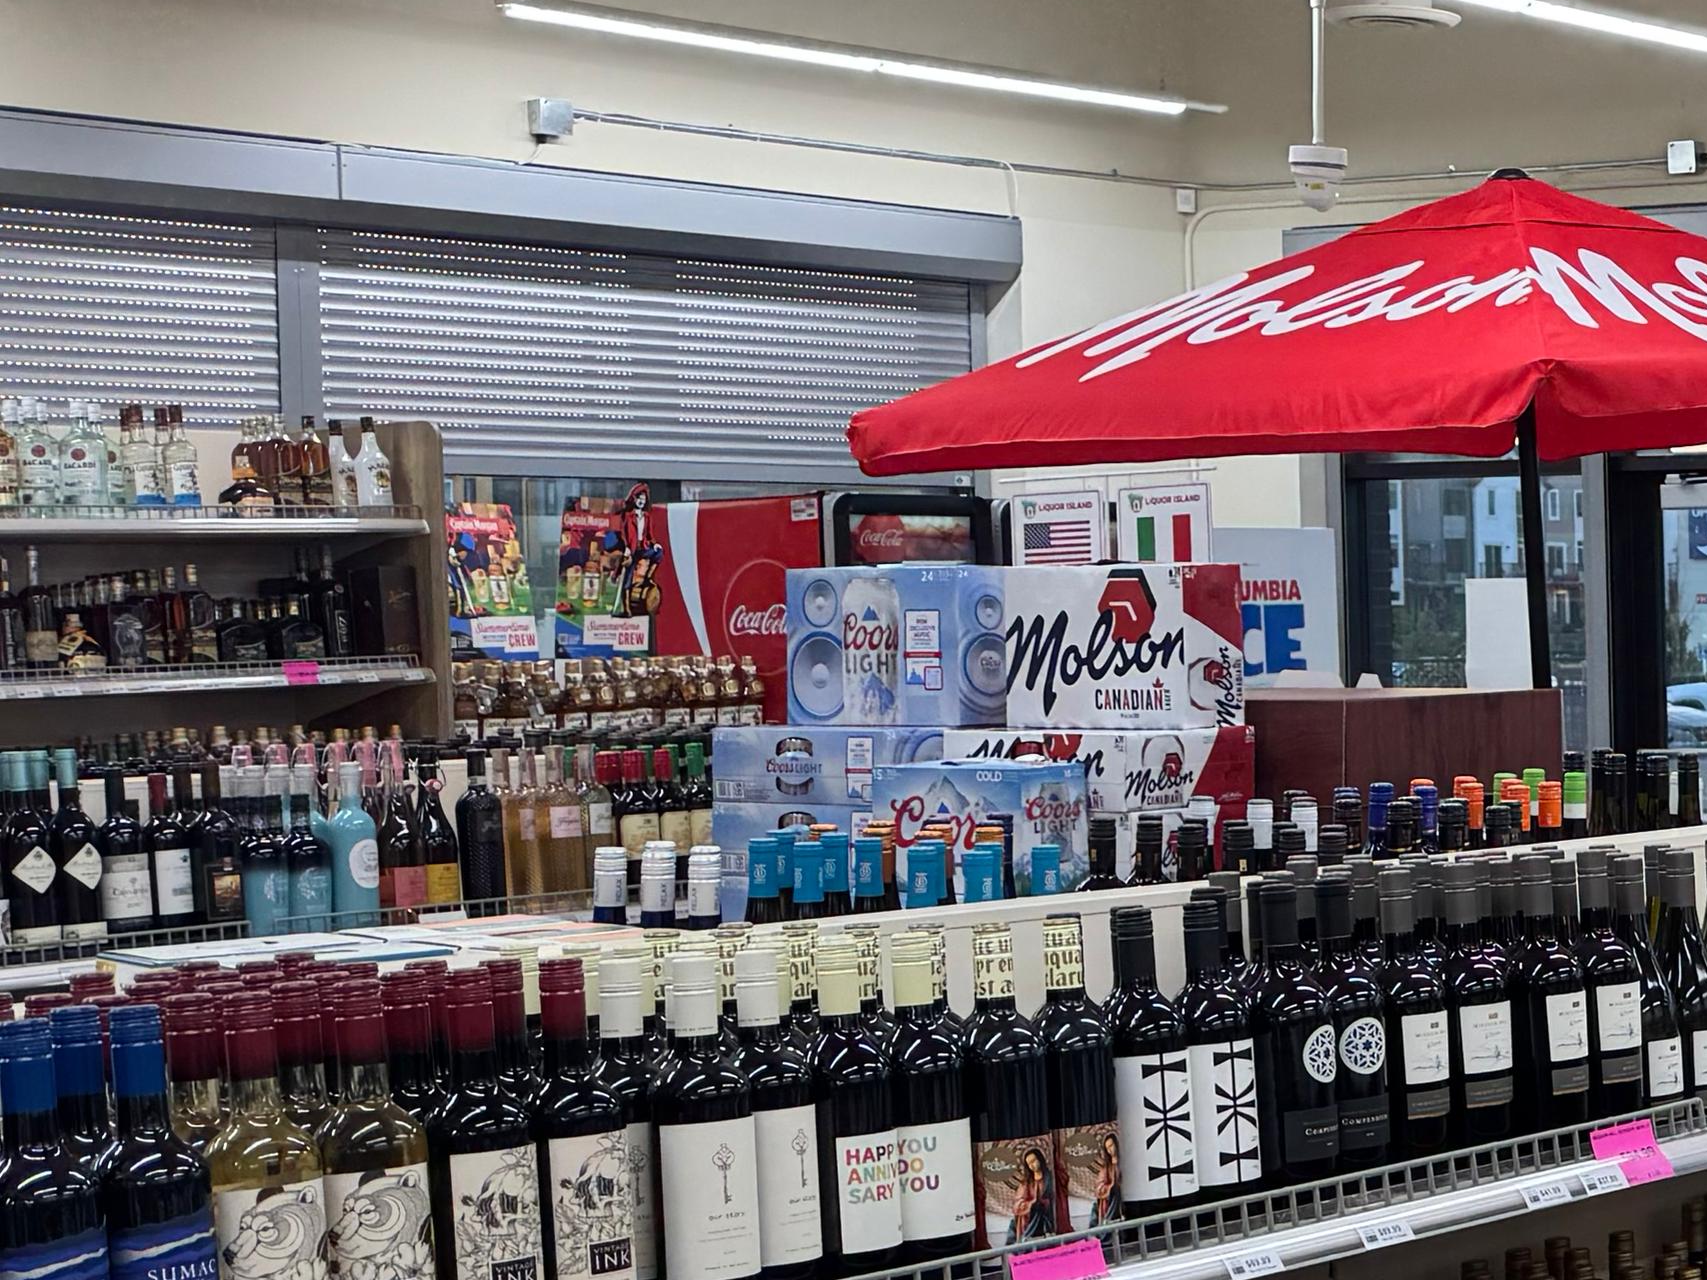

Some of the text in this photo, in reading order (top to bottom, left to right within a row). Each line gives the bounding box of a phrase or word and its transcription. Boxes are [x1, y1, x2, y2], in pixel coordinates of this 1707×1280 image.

[1015, 255, 1530, 383] Molson
[1066, 500, 1093, 510] ISLAND
[1173, 494, 1201, 504] ISLAND
[509, 633, 536, 647] CREW
[618, 632, 645, 645] CREW
[843, 613, 898, 650] Coors
[844, 653, 899, 674] LIGHT
[1006, 610, 1185, 718] Molson
[1095, 687, 1164, 711] CANADIAN
[976, 770, 1003, 782] COLD
[1126, 768, 1194, 802] Molson
[1025, 795, 1082, 821] Coors
[1034, 819, 1078, 834] LIGHT
[494, 1261, 535, 1275] VINTAGE
[594, 1250, 630, 1271] INK
